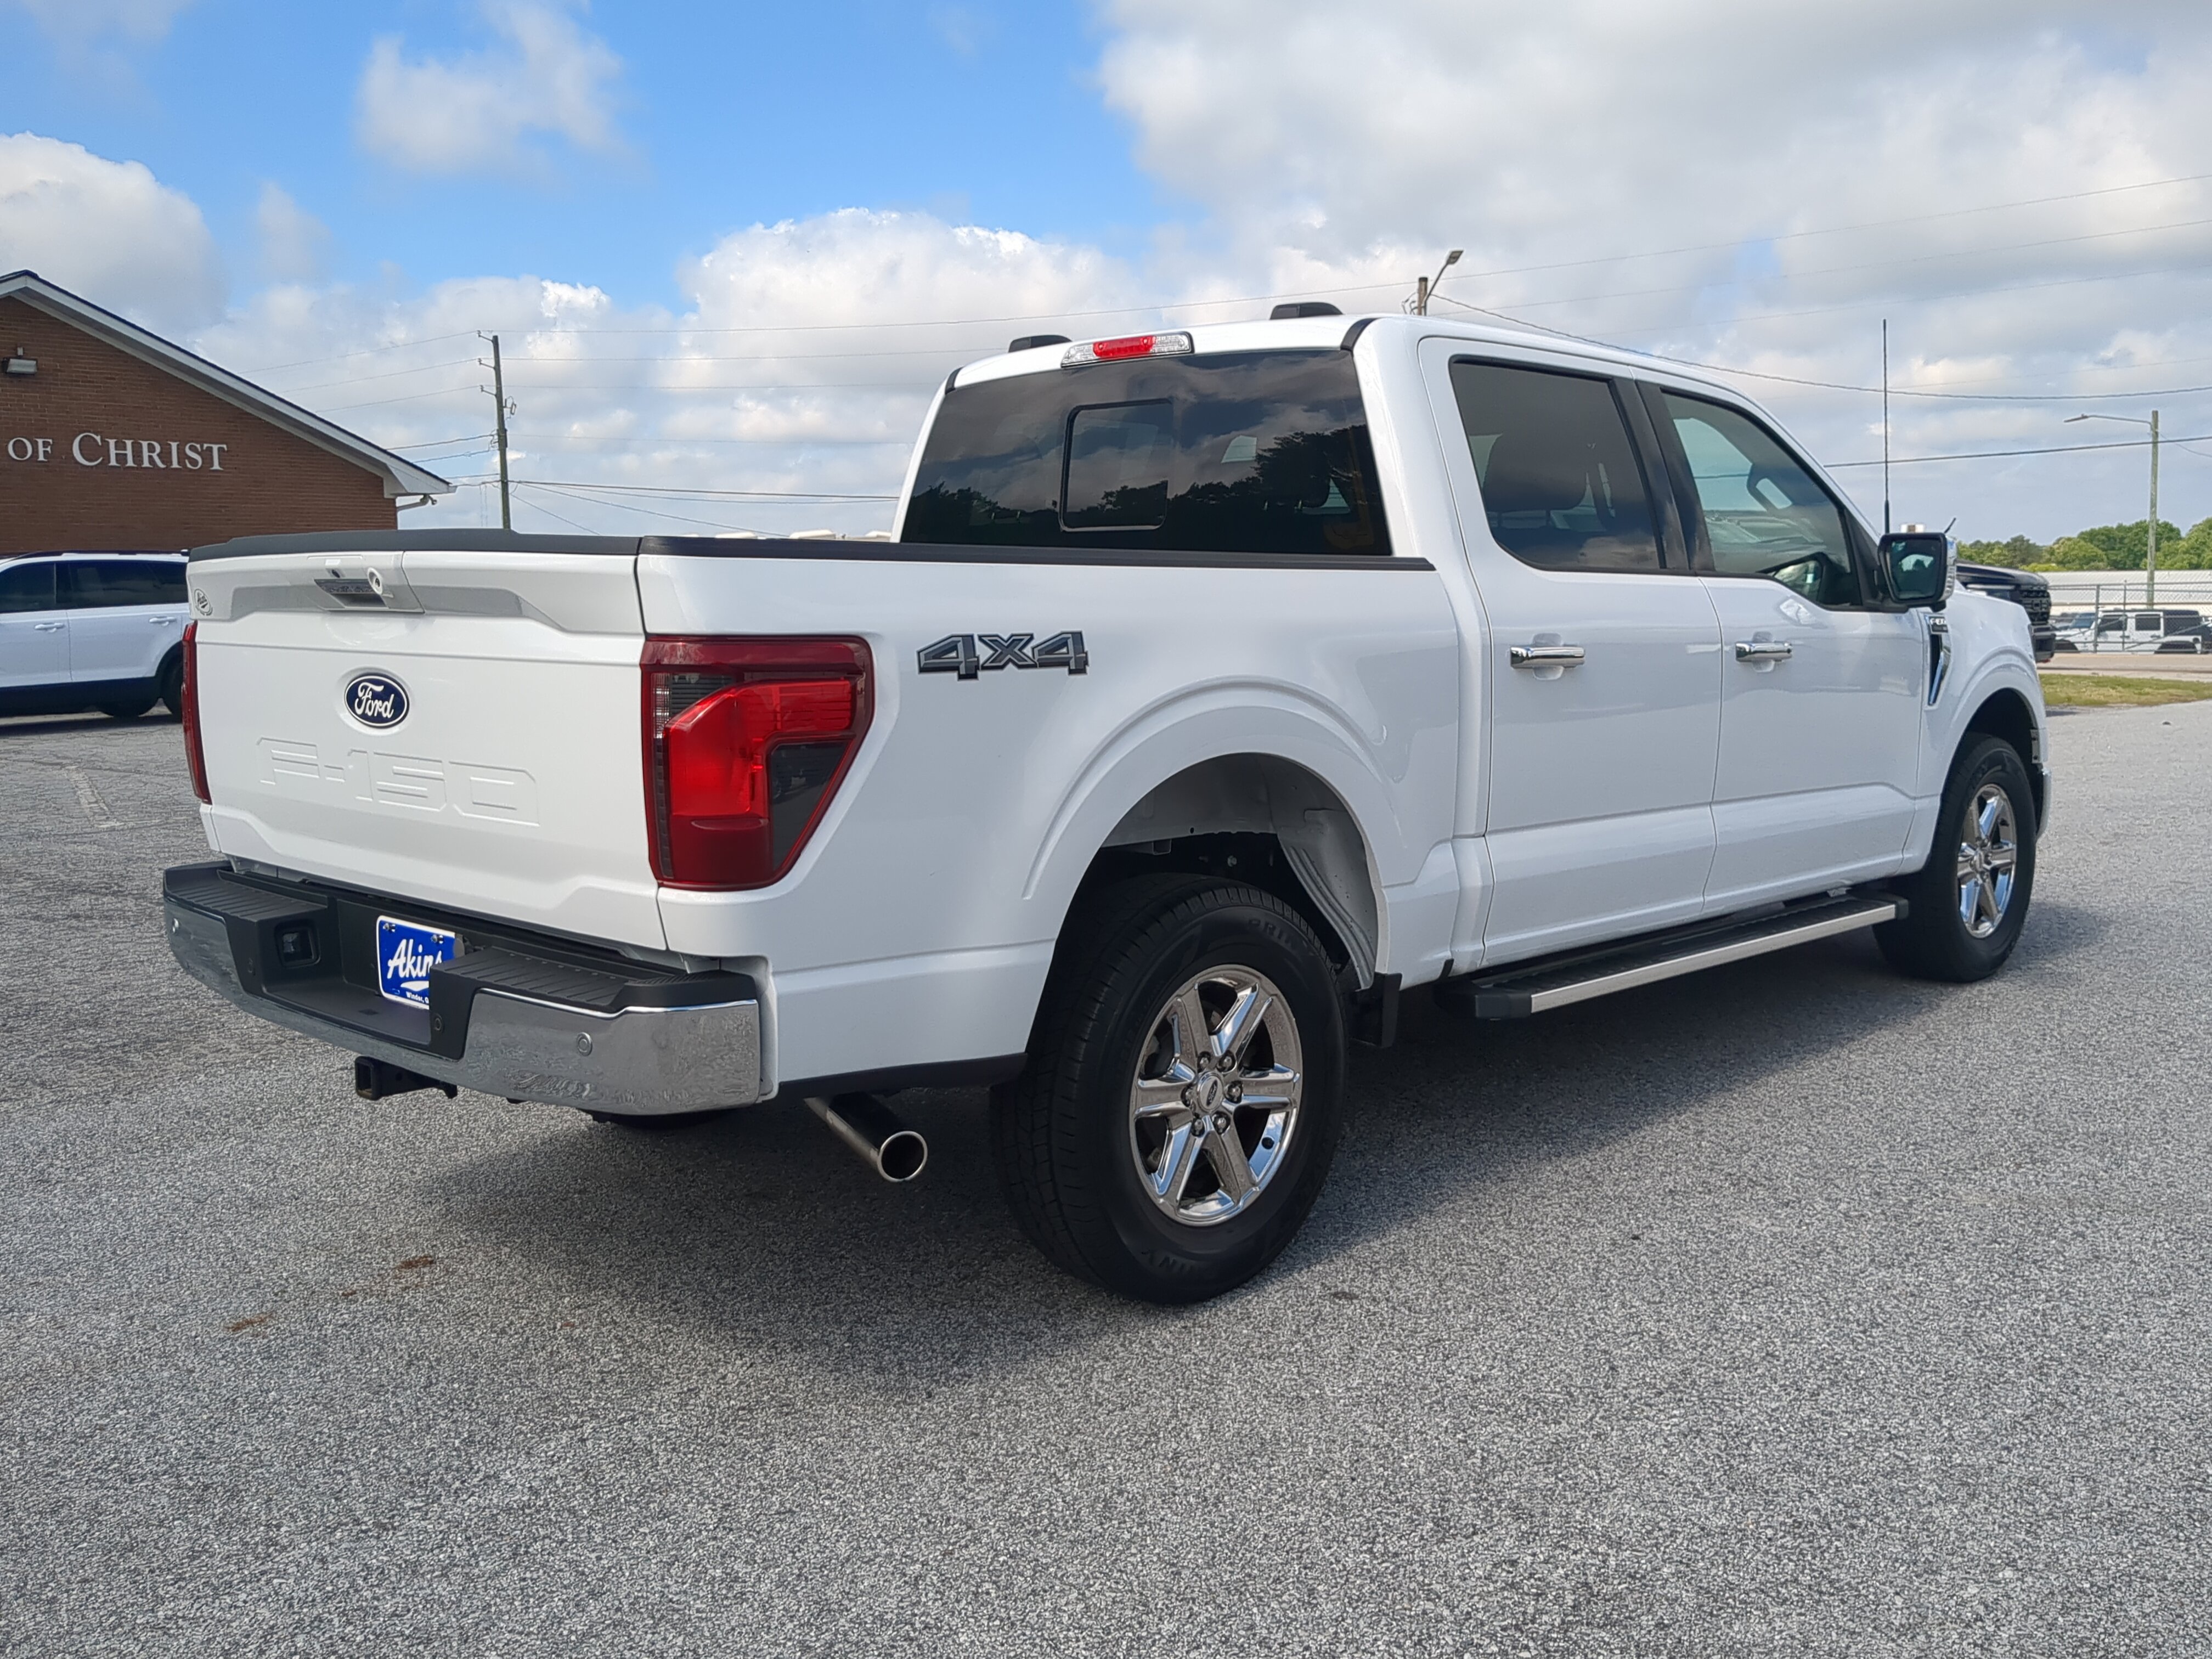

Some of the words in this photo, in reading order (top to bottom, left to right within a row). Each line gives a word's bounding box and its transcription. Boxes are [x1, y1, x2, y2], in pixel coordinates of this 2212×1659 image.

[8, 437, 53, 461] OF
[72, 432, 227, 470] CHRIST
[354, 682, 394, 718] Ford
[256, 737, 540, 827] F-150
